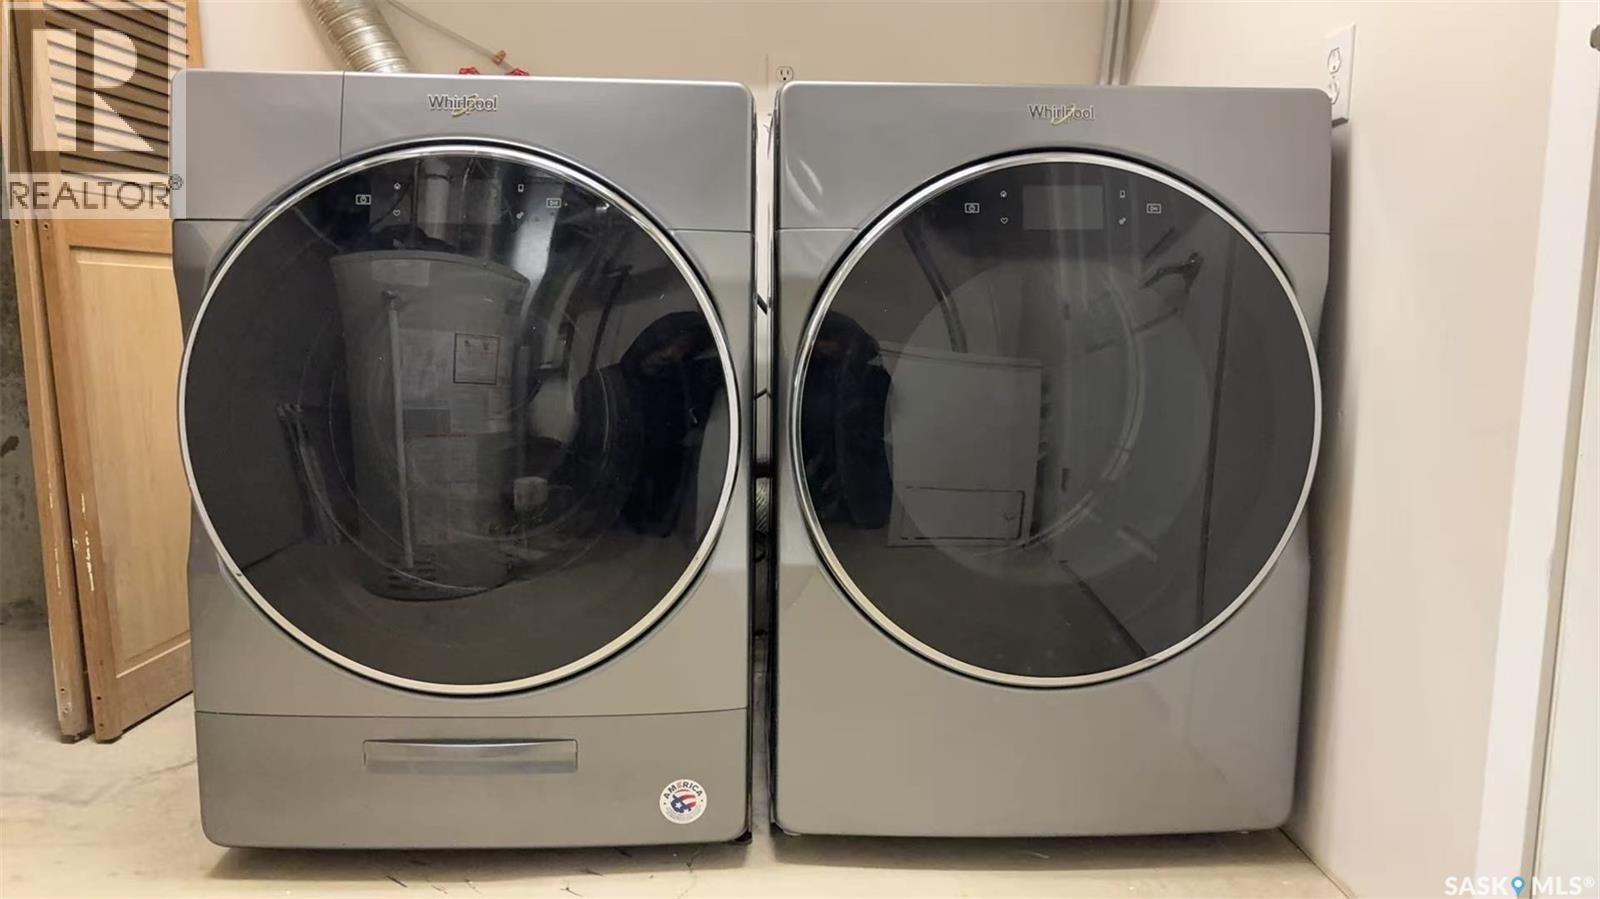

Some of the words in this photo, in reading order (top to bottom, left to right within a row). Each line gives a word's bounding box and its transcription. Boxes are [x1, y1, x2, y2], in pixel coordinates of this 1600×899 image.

[428, 94, 498, 115] Whirlpool
[1028, 104, 1095, 124] Whirlpool
[663, 781, 703, 799] AMERICA
